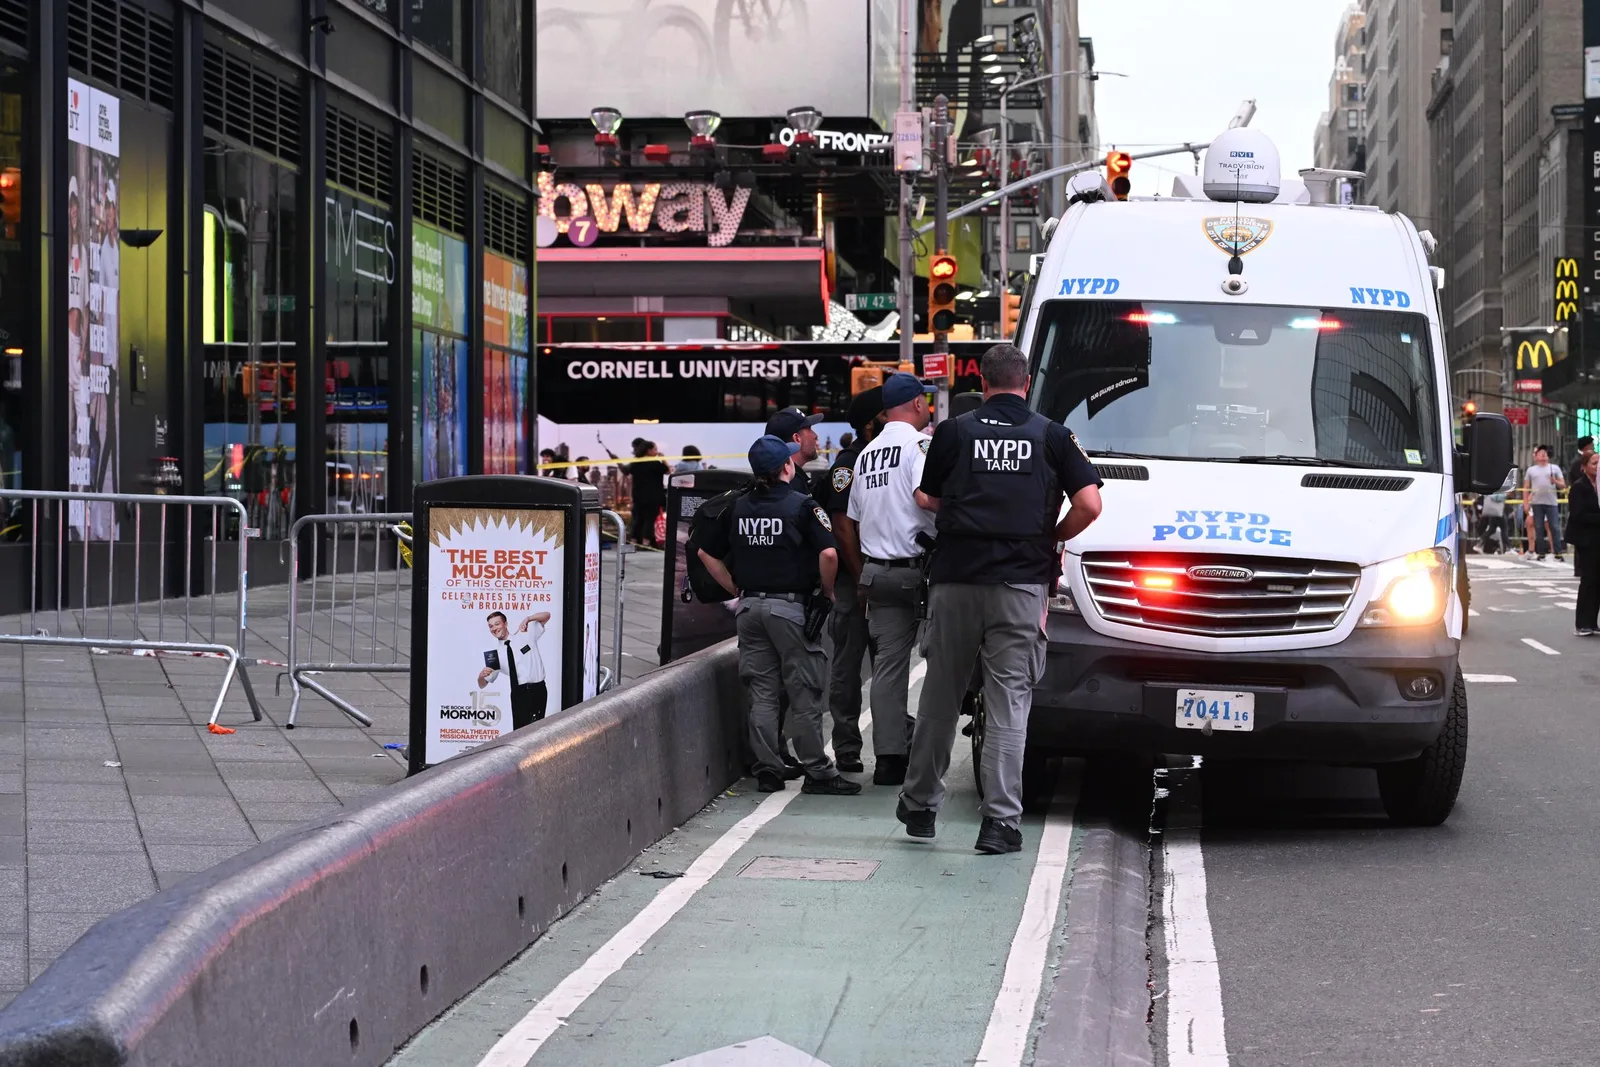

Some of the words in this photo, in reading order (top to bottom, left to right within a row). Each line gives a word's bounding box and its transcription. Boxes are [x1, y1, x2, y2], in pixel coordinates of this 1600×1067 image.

[99, 104, 107, 116] one
[98, 115, 110, 130] times
[98, 128, 112, 144] square
[576, 221, 590, 242] 7
[1242, 241, 1256, 252] NEW
[491, 277, 507, 312] times
[1058, 278, 1120, 295] NYPD
[859, 296, 868, 308] W
[872, 296, 884, 308] 42
[1350, 287, 1411, 308] NYPD
[567, 361, 673, 379] CORNELL
[679, 359, 819, 378] UNIVERSITY
[974, 439, 1032, 460] NYPD
[859, 446, 901, 476] NYPD
[985, 459, 1020, 471] TARU
[866, 472, 889, 490] TARU
[1175, 510, 1270, 526] NYPD
[738, 518, 783, 535] NYPD
[747, 535, 774, 546] TARU
[1152, 525, 1292, 547] POLICE
[494, 550, 548, 565] BEST
[452, 564, 542, 580] MUSICAL
[1196, 569, 1246, 578] FREIGHTLINER
[465, 580, 490, 588] THIS
[507, 593, 517, 602] 15
[521, 593, 551, 602] YEARS
[479, 602, 531, 611] BROADWAY
[440, 710, 495, 720] MORMON
[1184, 698, 1230, 720] 7041
[1234, 711, 1248, 722] 16
